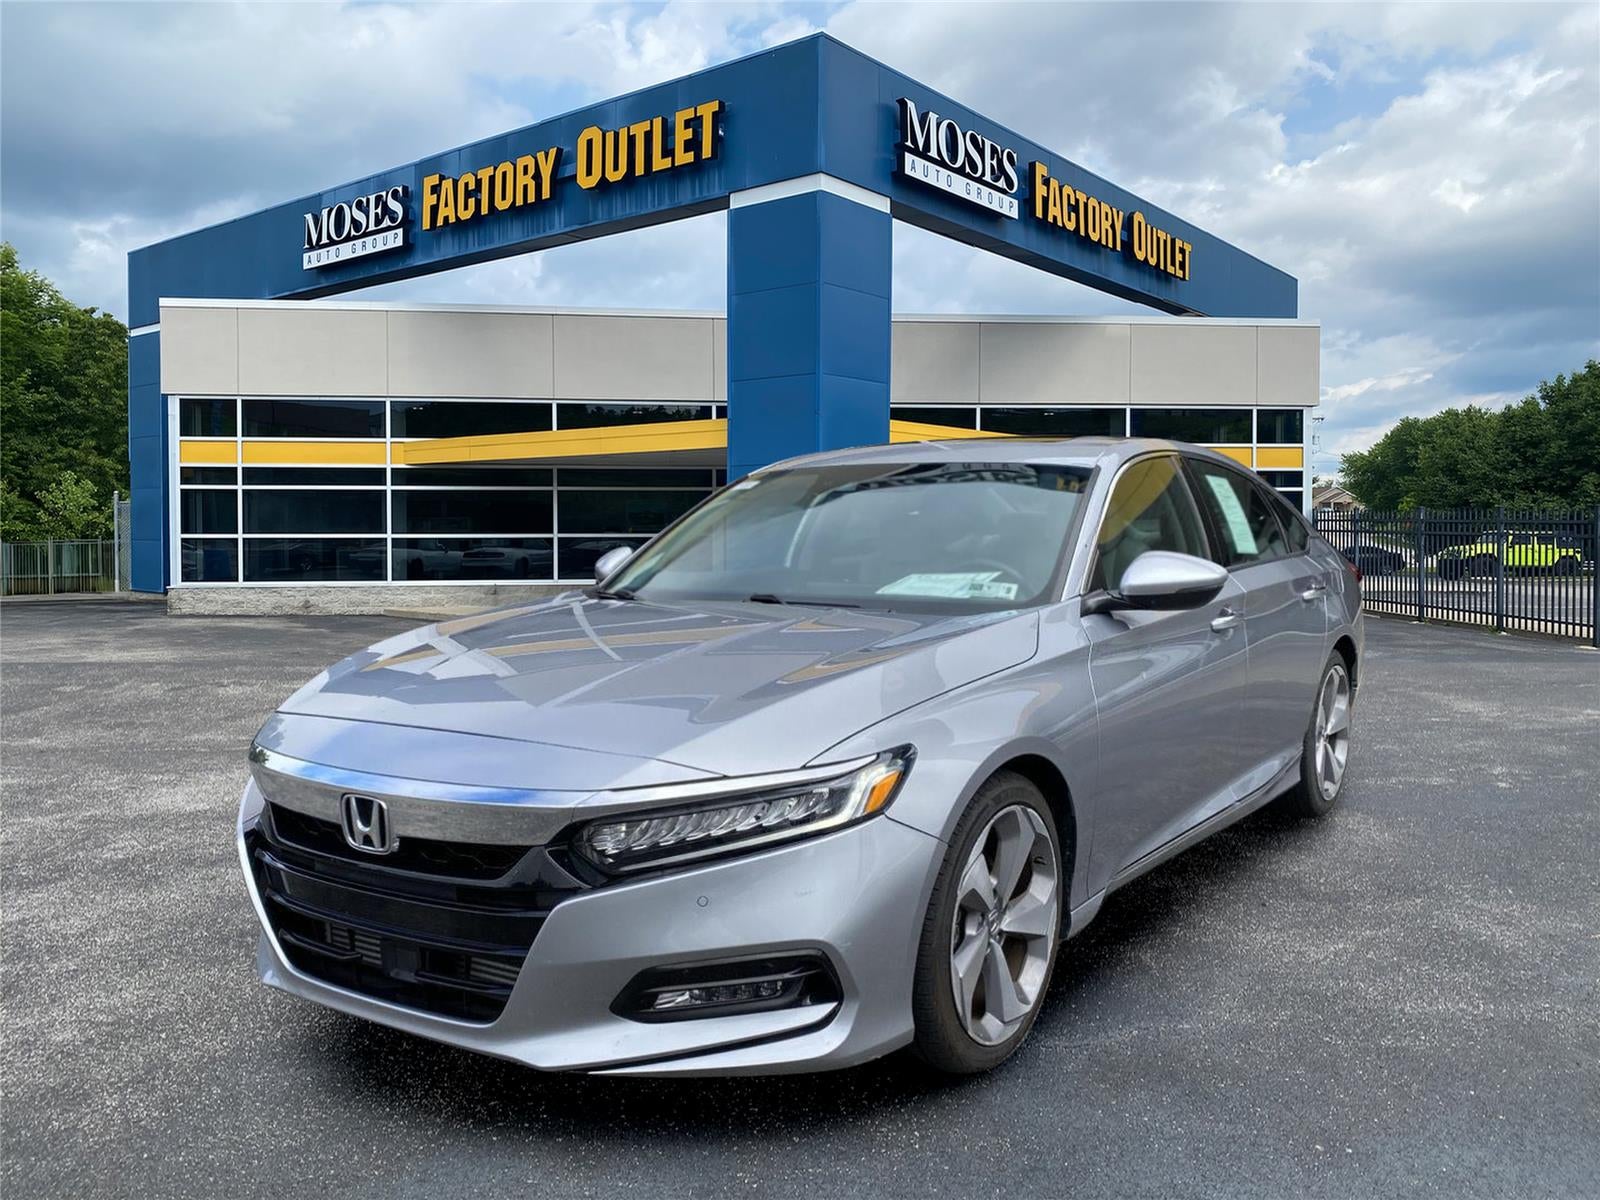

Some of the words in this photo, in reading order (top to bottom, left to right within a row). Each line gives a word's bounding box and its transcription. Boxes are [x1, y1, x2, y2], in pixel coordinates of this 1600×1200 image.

[421, 147, 560, 230] FACTORY
[576, 99, 720, 190] OUTLET
[904, 97, 1019, 194] MOSES
[303, 185, 404, 249] MOSES
[910, 158, 953, 188] AUTO
[965, 181, 1015, 214] GROUP
[1035, 161, 1125, 252] FACTORY
[1132, 210, 1193, 281] OUTLET
[307, 247, 341, 265] AUTO
[351, 232, 399, 254] GROUP
